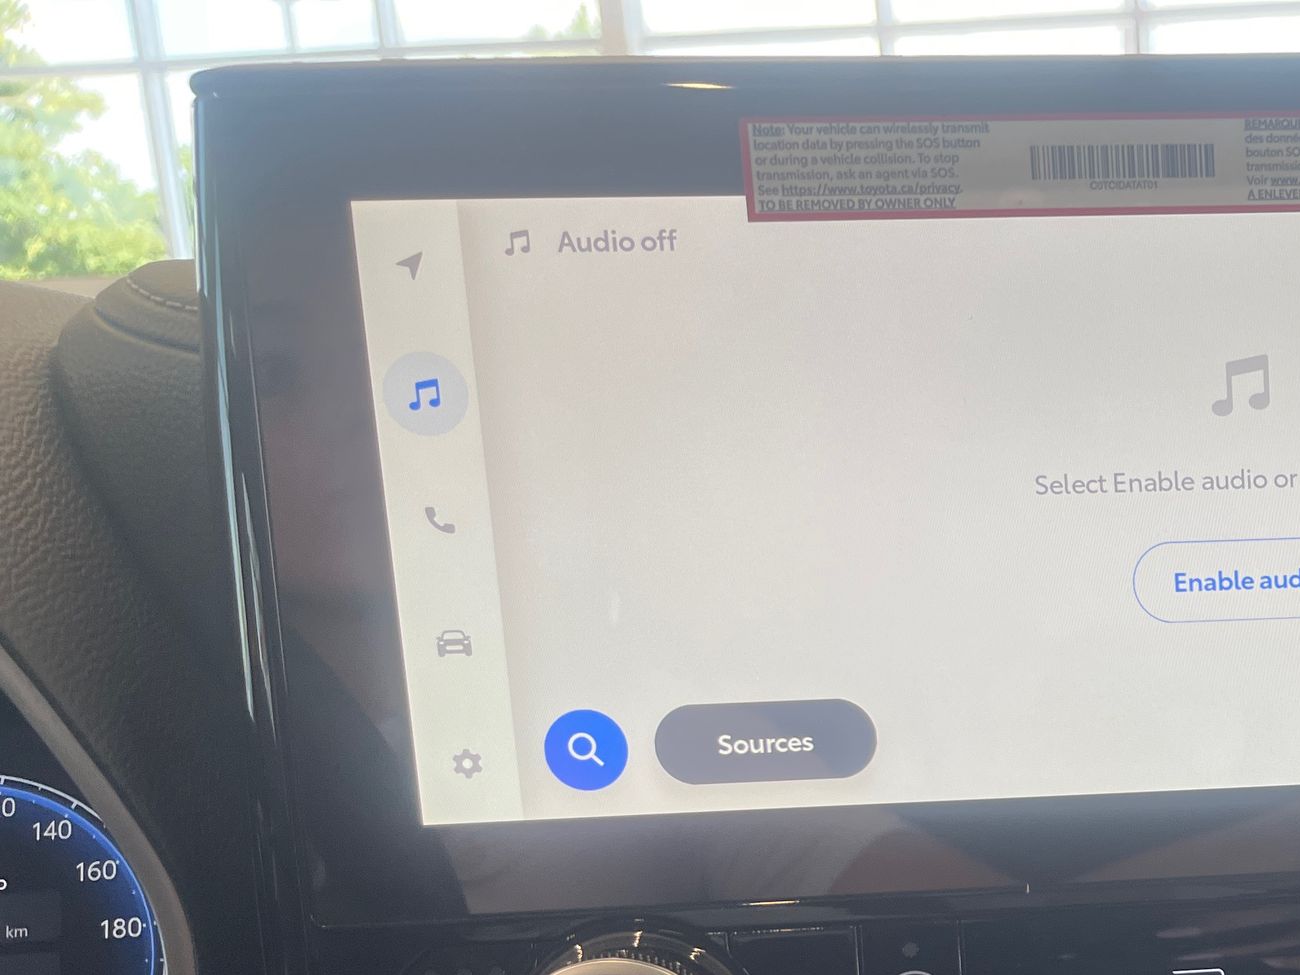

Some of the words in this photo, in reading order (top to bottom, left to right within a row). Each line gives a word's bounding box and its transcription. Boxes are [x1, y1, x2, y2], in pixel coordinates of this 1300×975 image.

[787, 124, 814, 135] Your
[816, 122, 857, 134] vehicle
[860, 125, 880, 134] can
[882, 122, 939, 136] wirelessly
[942, 121, 990, 133] transmit
[753, 140, 799, 151] location
[802, 140, 828, 150] data
[830, 139, 843, 152] by
[846, 138, 893, 152] pressing
[895, 138, 913, 149] the
[917, 138, 940, 149] SOS
[943, 138, 980, 148] button
[769, 155, 807, 167] during
[820, 153, 861, 164] vehicle
[918, 153, 931, 164] To
[933, 153, 960, 166] stop
[836, 169, 856, 179] ask
[860, 171, 872, 179] an
[875, 169, 909, 181] agent
[912, 168, 928, 178] via
[758, 185, 779, 196] See
[759, 200, 776, 212] TO
[779, 200, 794, 211] BE
[796, 199, 856, 211] REMOVED
[860, 199, 872, 210] BY
[875, 198, 921, 210] OWNER
[923, 196, 956, 209] ONLY
[558, 230, 635, 253] Audio
[641, 229, 677, 251] off
[1034, 472, 1108, 496] Select
[1113, 469, 1196, 493] Enable
[1201, 468, 1268, 491] audio
[1273, 470, 1298, 488] or
[1174, 570, 1255, 592] Enable
[718, 733, 814, 755] Sources
[32, 819, 72, 841] 140
[76, 860, 117, 882] 160
[6, 925, 28, 938] km
[100, 917, 142, 939] 180
